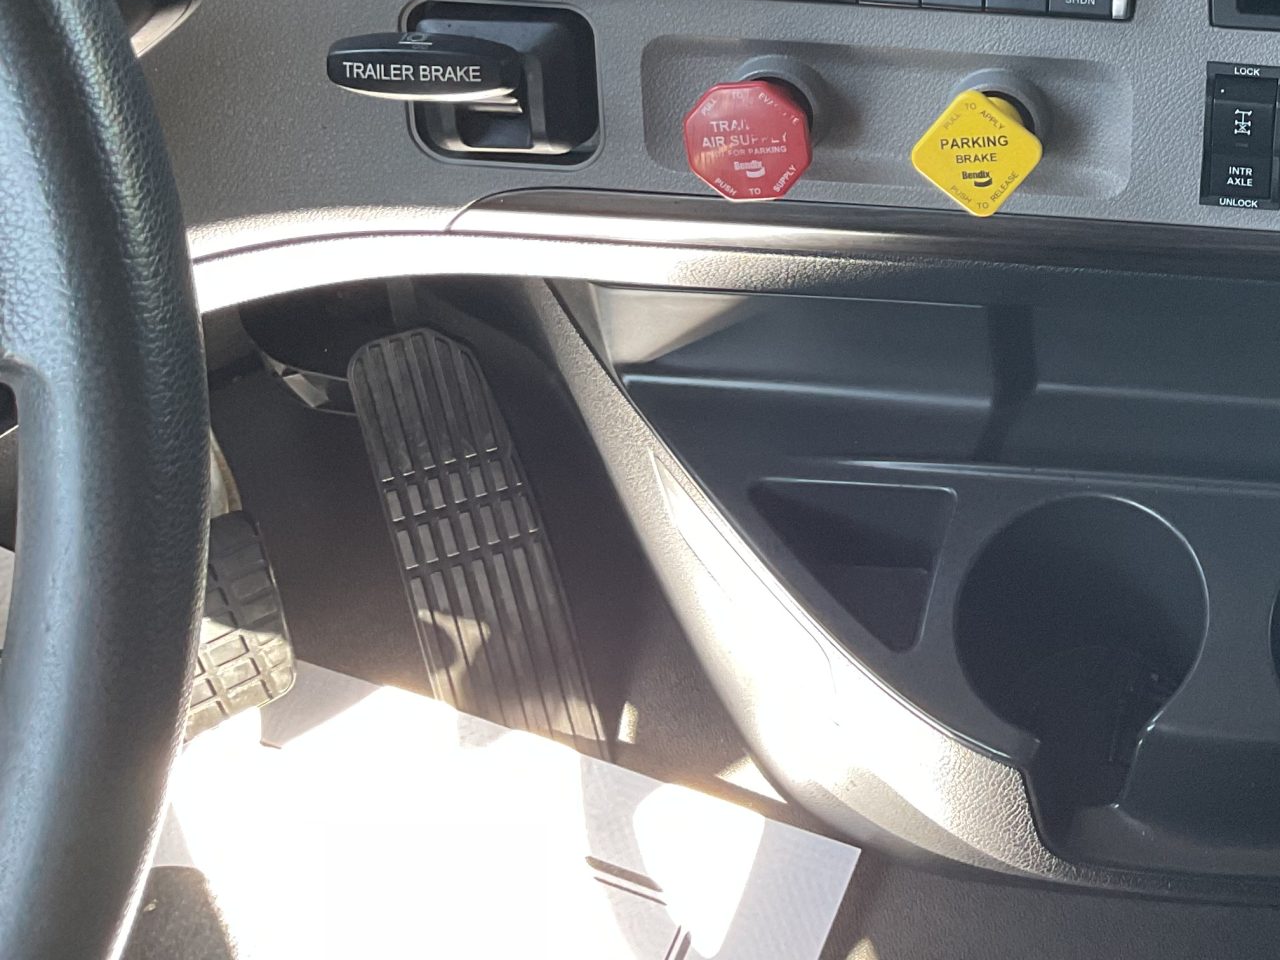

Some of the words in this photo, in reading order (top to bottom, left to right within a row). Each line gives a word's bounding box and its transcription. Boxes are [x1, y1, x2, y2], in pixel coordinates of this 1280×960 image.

[343, 61, 414, 81] TRAILER
[419, 65, 482, 83] BRAKE
[1234, 66, 1260, 77] LOCK
[965, 102, 977, 111] TO
[980, 109, 1006, 130] APPLY
[702, 134, 726, 148] AIR
[940, 135, 1009, 150] PARKING
[748, 145, 788, 156] PARKING
[955, 152, 998, 164] BRAKE
[961, 169, 991, 180] Bendix
[1228, 166, 1253, 177] INTR
[714, 178, 737, 197] PUSH
[748, 187, 762, 196] TO
[773, 164, 798, 193] SUPPLY
[1226, 177, 1253, 188] AXLE
[976, 201, 990, 209] TO
[989, 170, 1020, 202] RELEASE
[1218, 197, 1259, 209] UNLOCK
